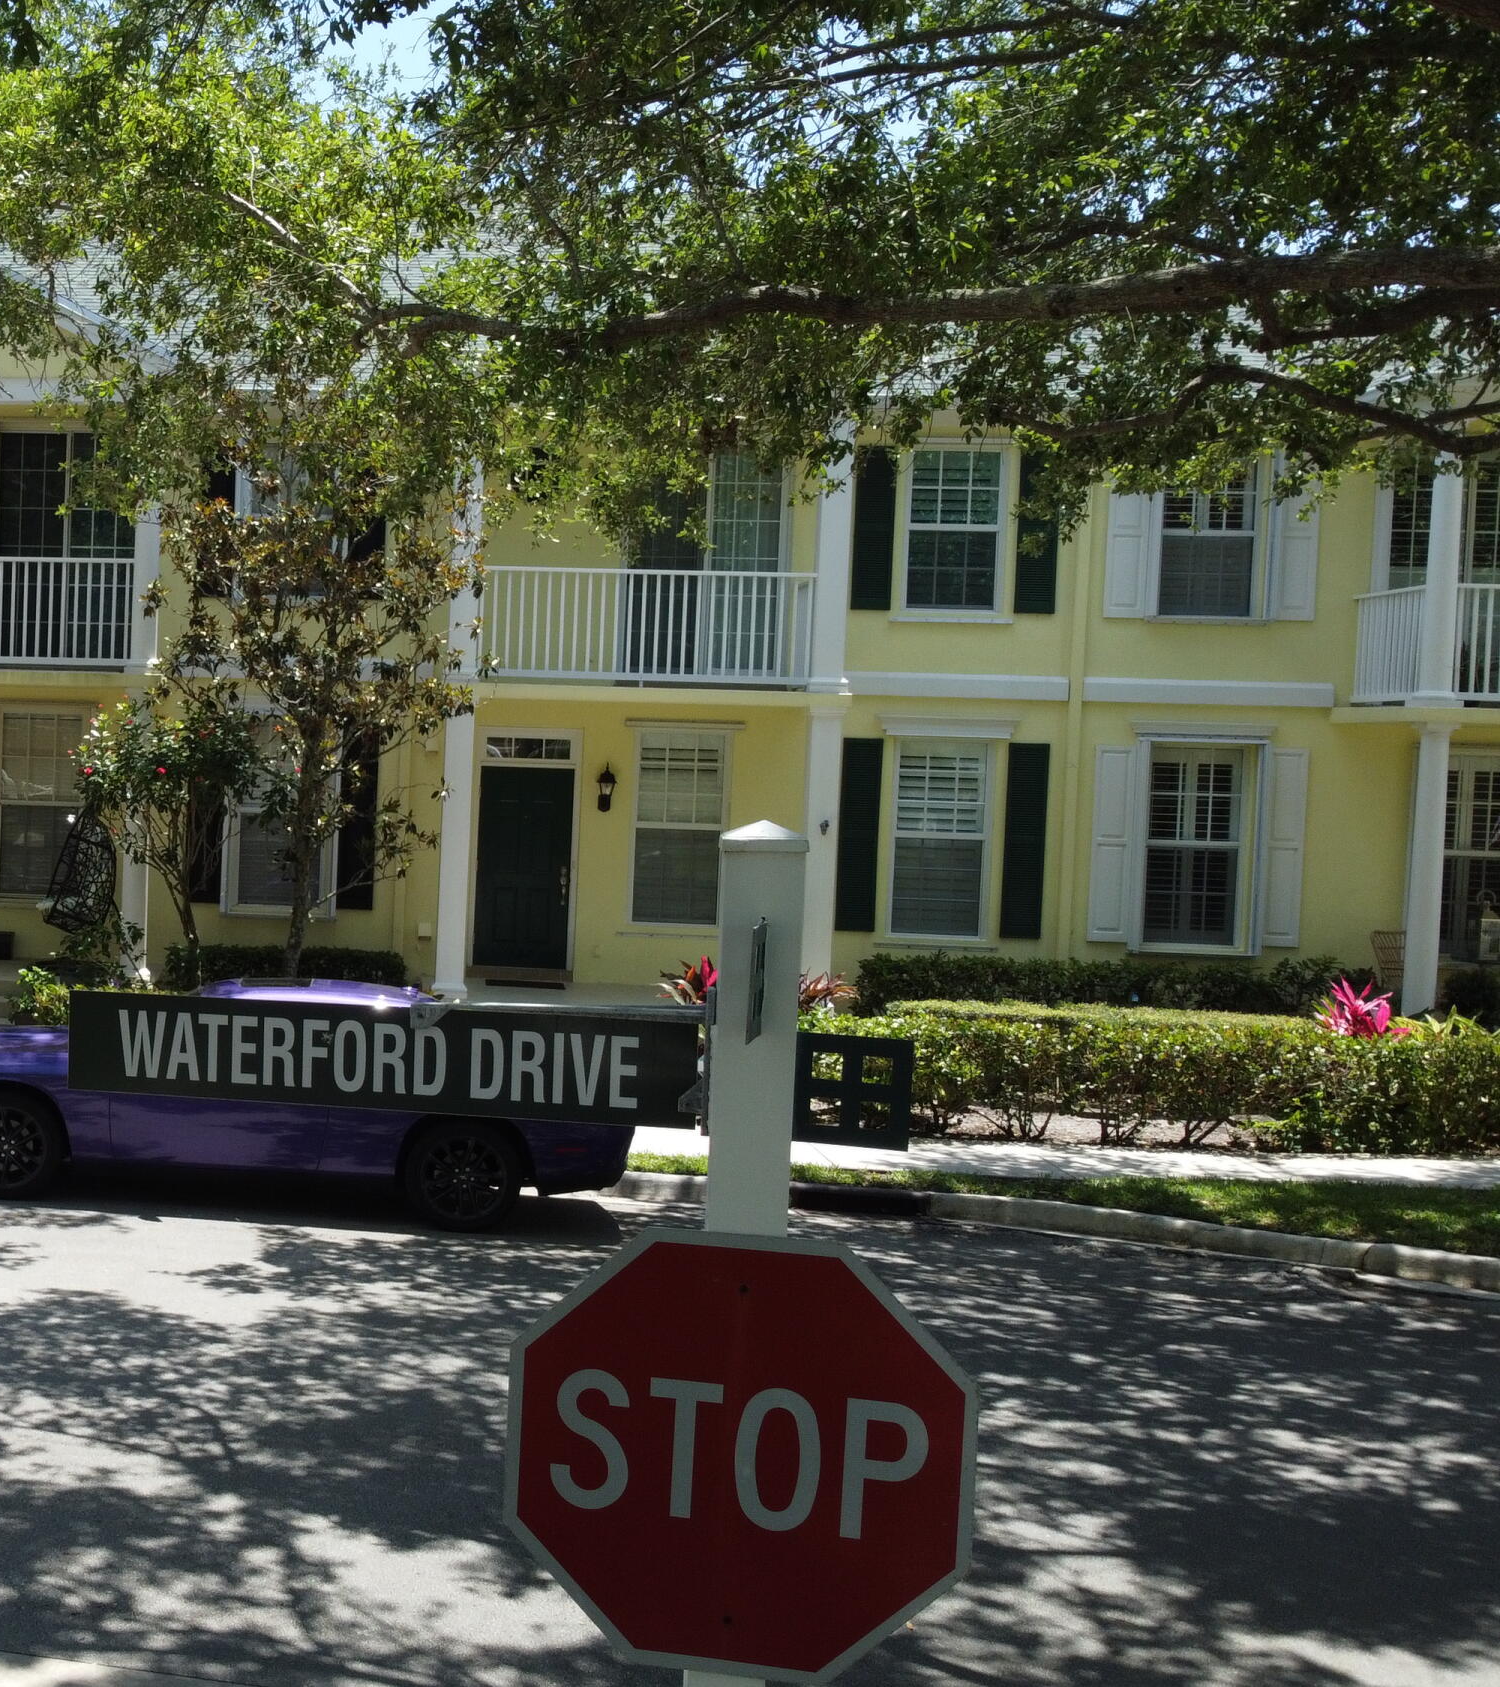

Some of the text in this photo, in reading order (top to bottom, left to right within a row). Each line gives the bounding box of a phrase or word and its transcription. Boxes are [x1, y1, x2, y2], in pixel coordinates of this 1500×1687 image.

[118, 1009, 640, 1109] WATERFORD DRIVE
[550, 1368, 929, 1540] STOP
